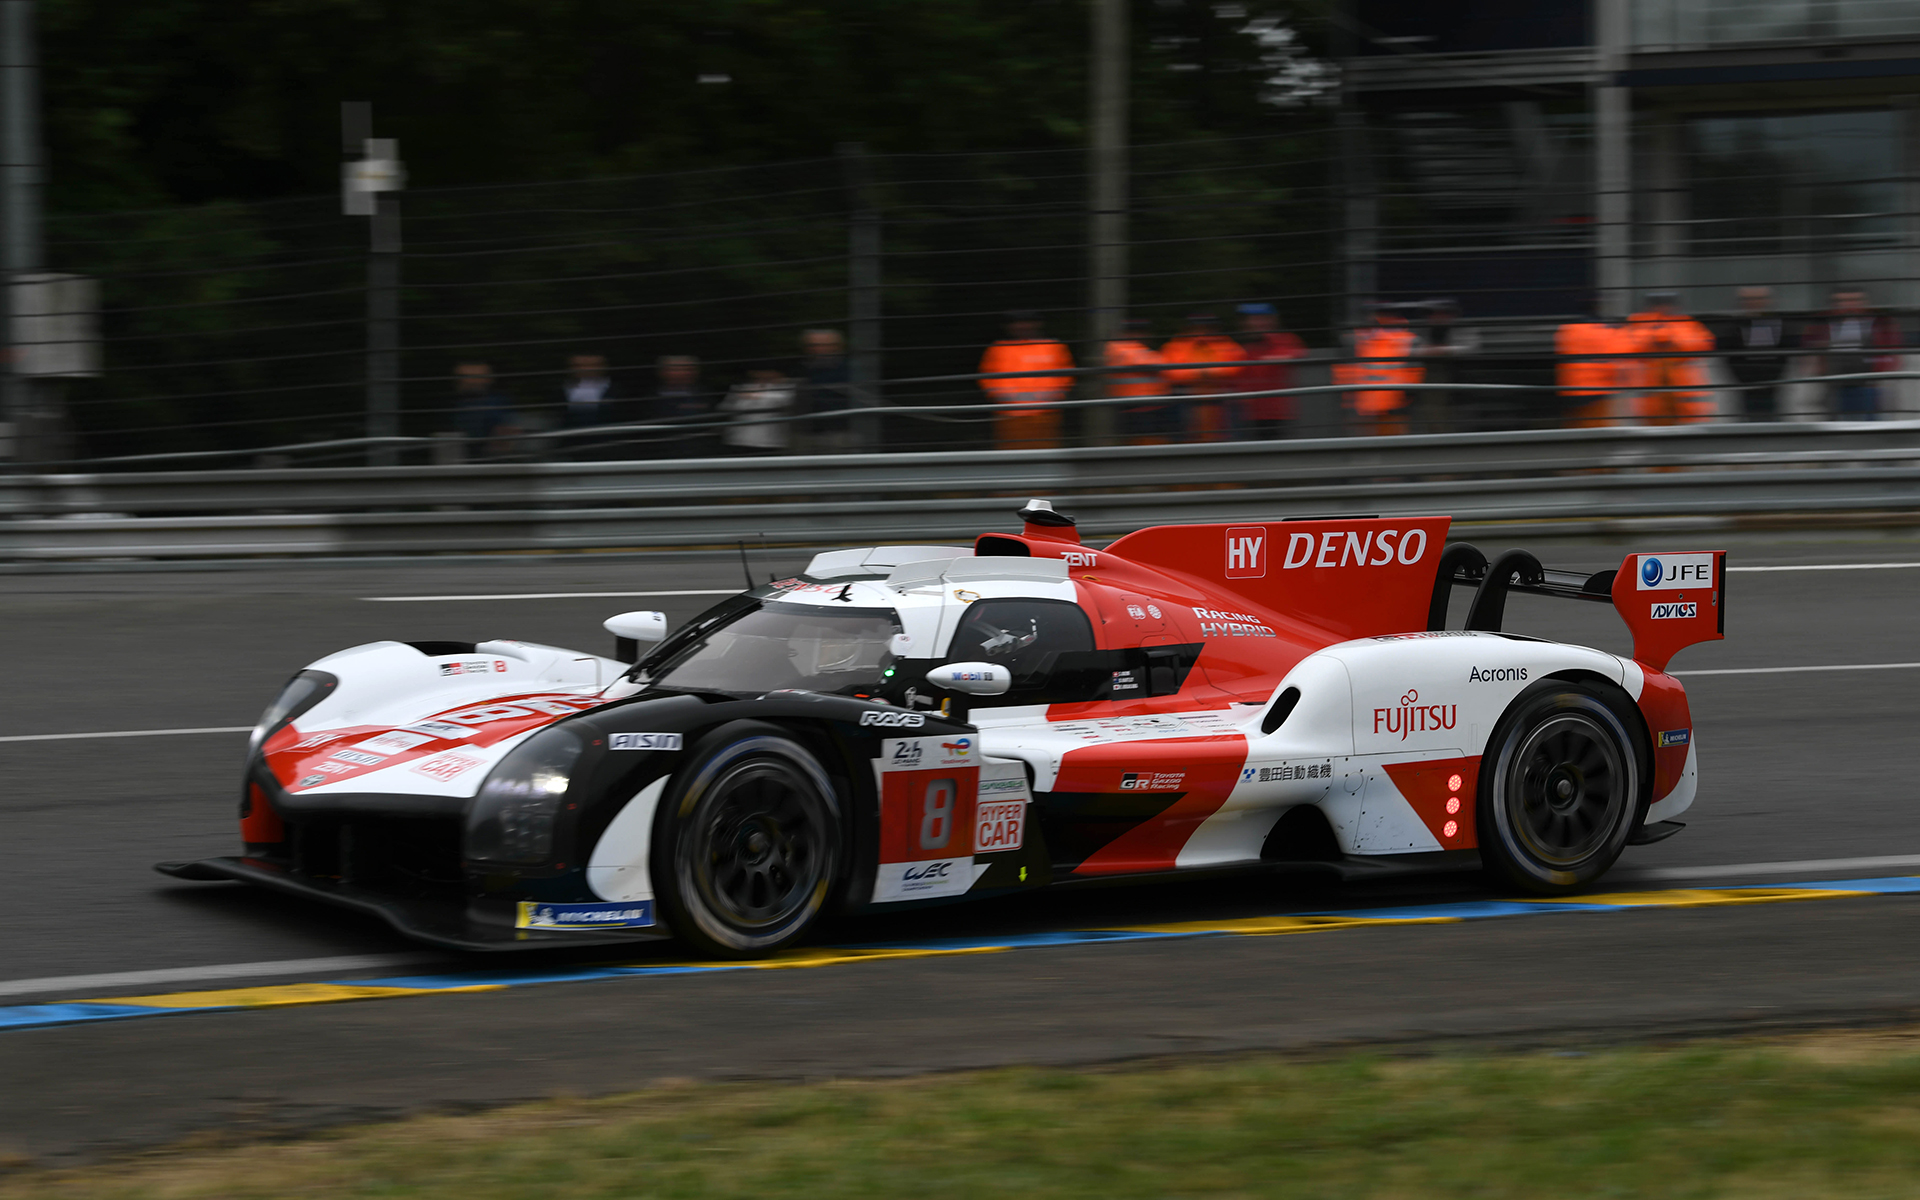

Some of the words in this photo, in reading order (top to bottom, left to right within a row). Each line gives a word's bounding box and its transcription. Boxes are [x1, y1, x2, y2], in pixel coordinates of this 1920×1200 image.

[1229, 537, 1262, 569] HY
[1283, 528, 1427, 569] DENSO
[1060, 551, 1098, 567] ZENT
[1665, 564, 1709, 581] JFE
[1652, 604, 1696, 618] ADVICS
[1201, 623, 1277, 637] HYBRID
[494, 660, 508, 672] 8
[1469, 665, 1528, 683] Acronis
[952, 672, 981, 681] Mobil
[437, 704, 535, 724] 8
[859, 711, 925, 727] RAYS
[1373, 704, 1457, 741] FUJITSU
[611, 735, 679, 749] AISIN
[1120, 779, 1150, 789] GR
[919, 778, 957, 850] 8
[980, 804, 1021, 821] HYPER
[979, 820, 1019, 847] CAR
[902, 862, 954, 880] WEC
[557, 908, 644, 922] MICHELIN
